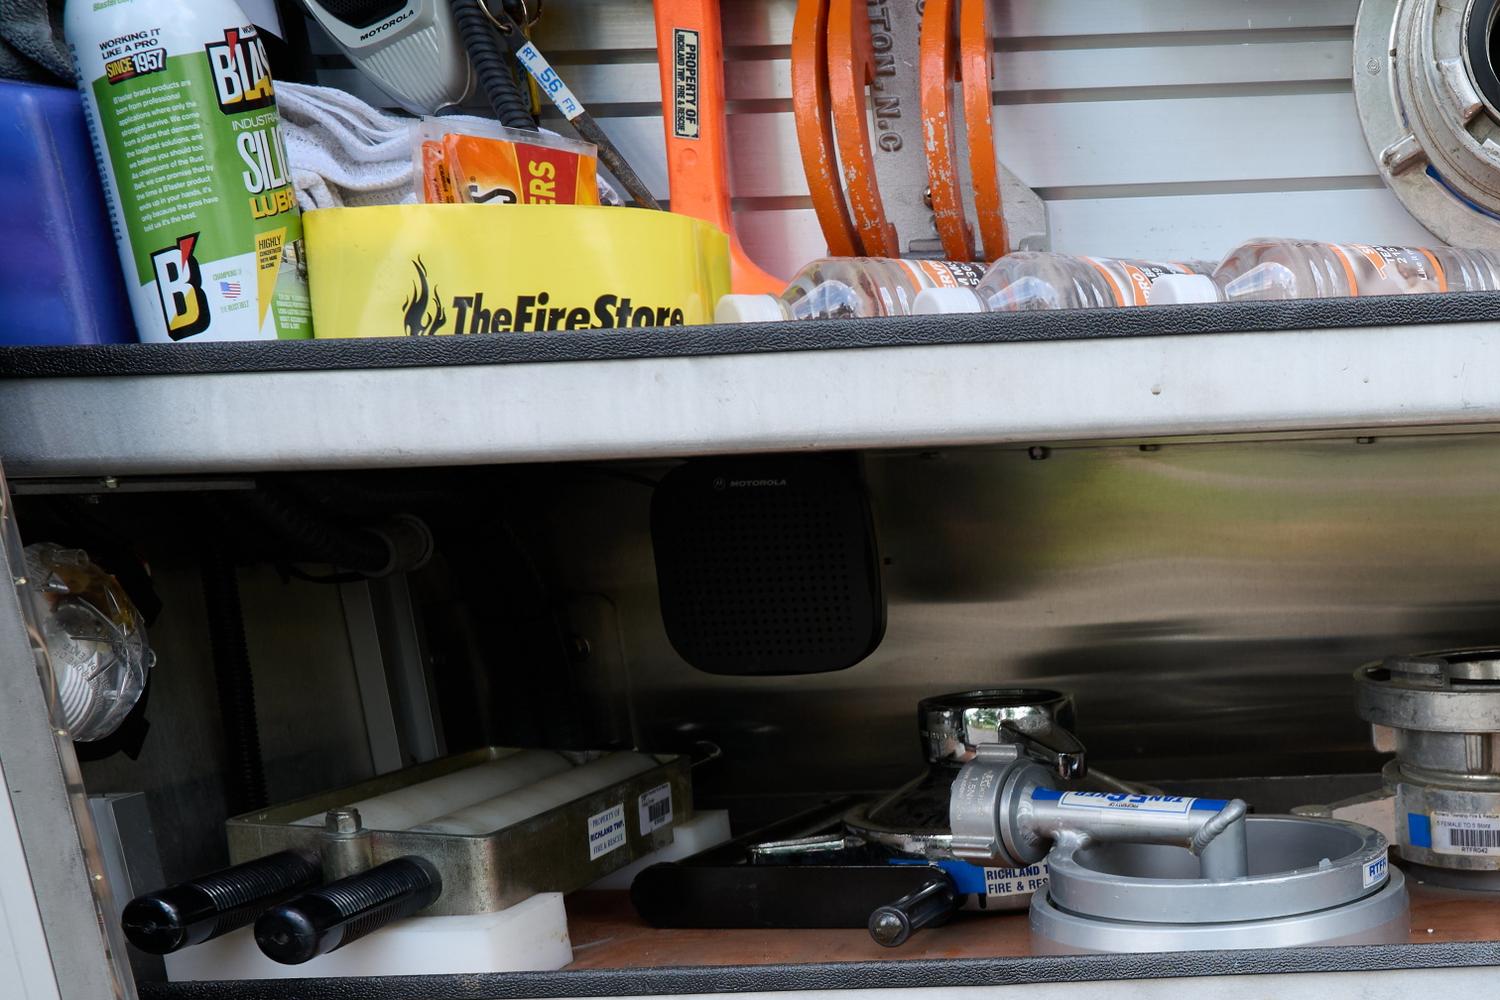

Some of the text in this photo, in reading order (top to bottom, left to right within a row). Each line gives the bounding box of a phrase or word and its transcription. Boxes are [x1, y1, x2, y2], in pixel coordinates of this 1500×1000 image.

[360, 10, 414, 41] MOTOROLA
[100, 28, 160, 50] WORKING IT
[102, 47, 122, 60] LIKE
[134, 38, 158, 49] PRO
[106, 49, 163, 78] SINCE 1957
[522, 47, 576, 113] RT 56 FR
[685, 43, 696, 124] PROPERTY OF
[259, 235, 281, 249] HIGHLY
[452, 292, 684, 335] TheFireStore
[730, 478, 787, 487] MOTOROLA
[986, 866, 1040, 880] RICHLAND
[988, 881, 1024, 894] FIRE &
